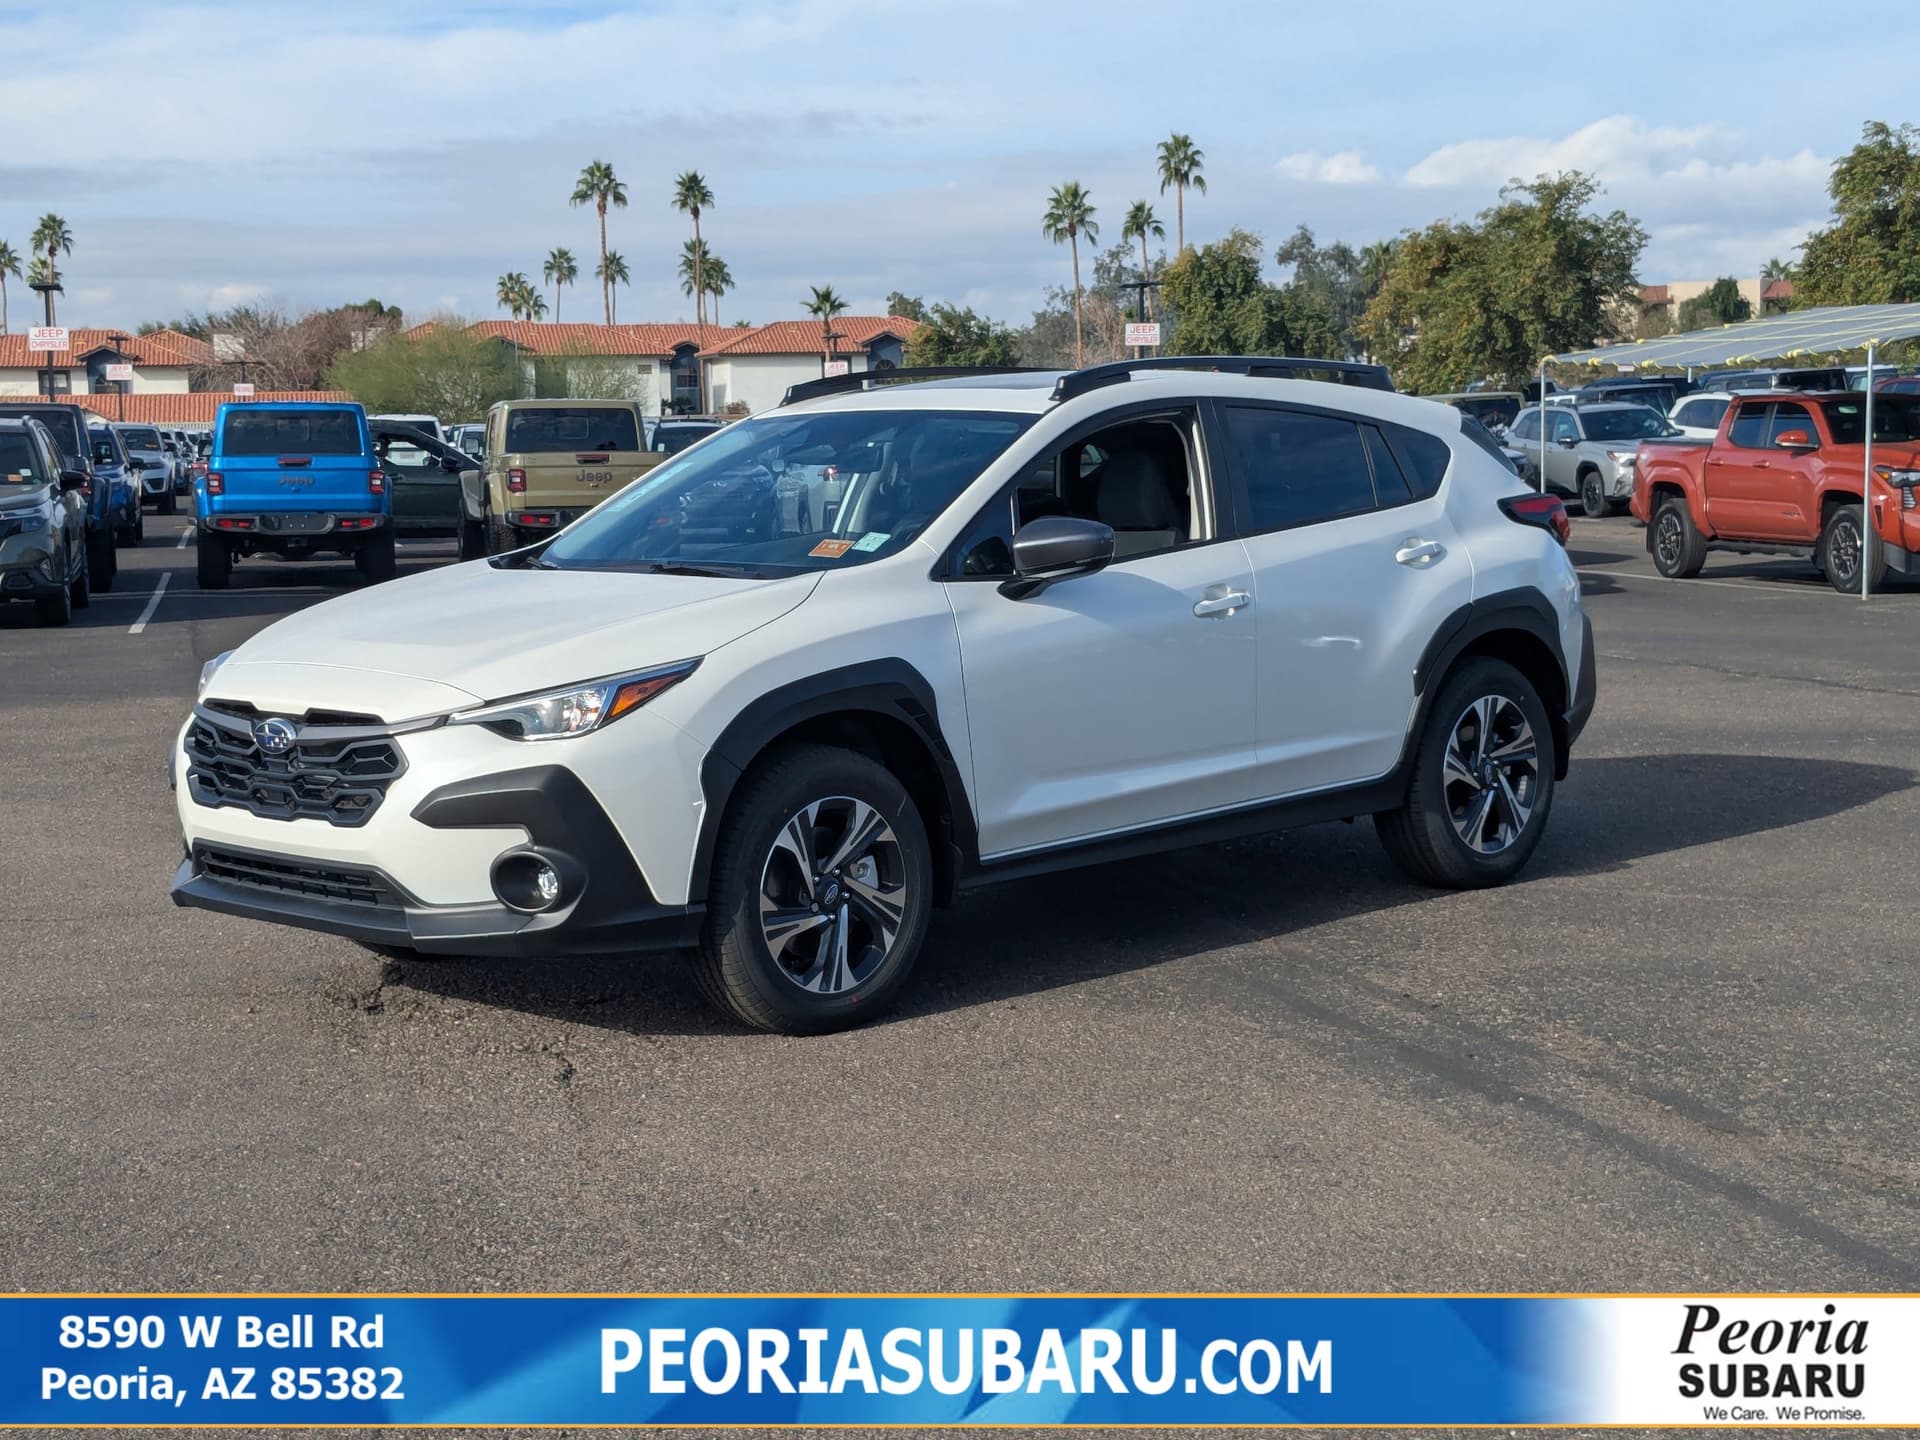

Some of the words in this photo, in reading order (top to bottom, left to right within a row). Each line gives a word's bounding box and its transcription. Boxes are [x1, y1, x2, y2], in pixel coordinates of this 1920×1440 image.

[34, 329, 64, 338] JEEP
[1130, 325, 1156, 334] JEEP
[576, 468, 613, 484] Jeep
